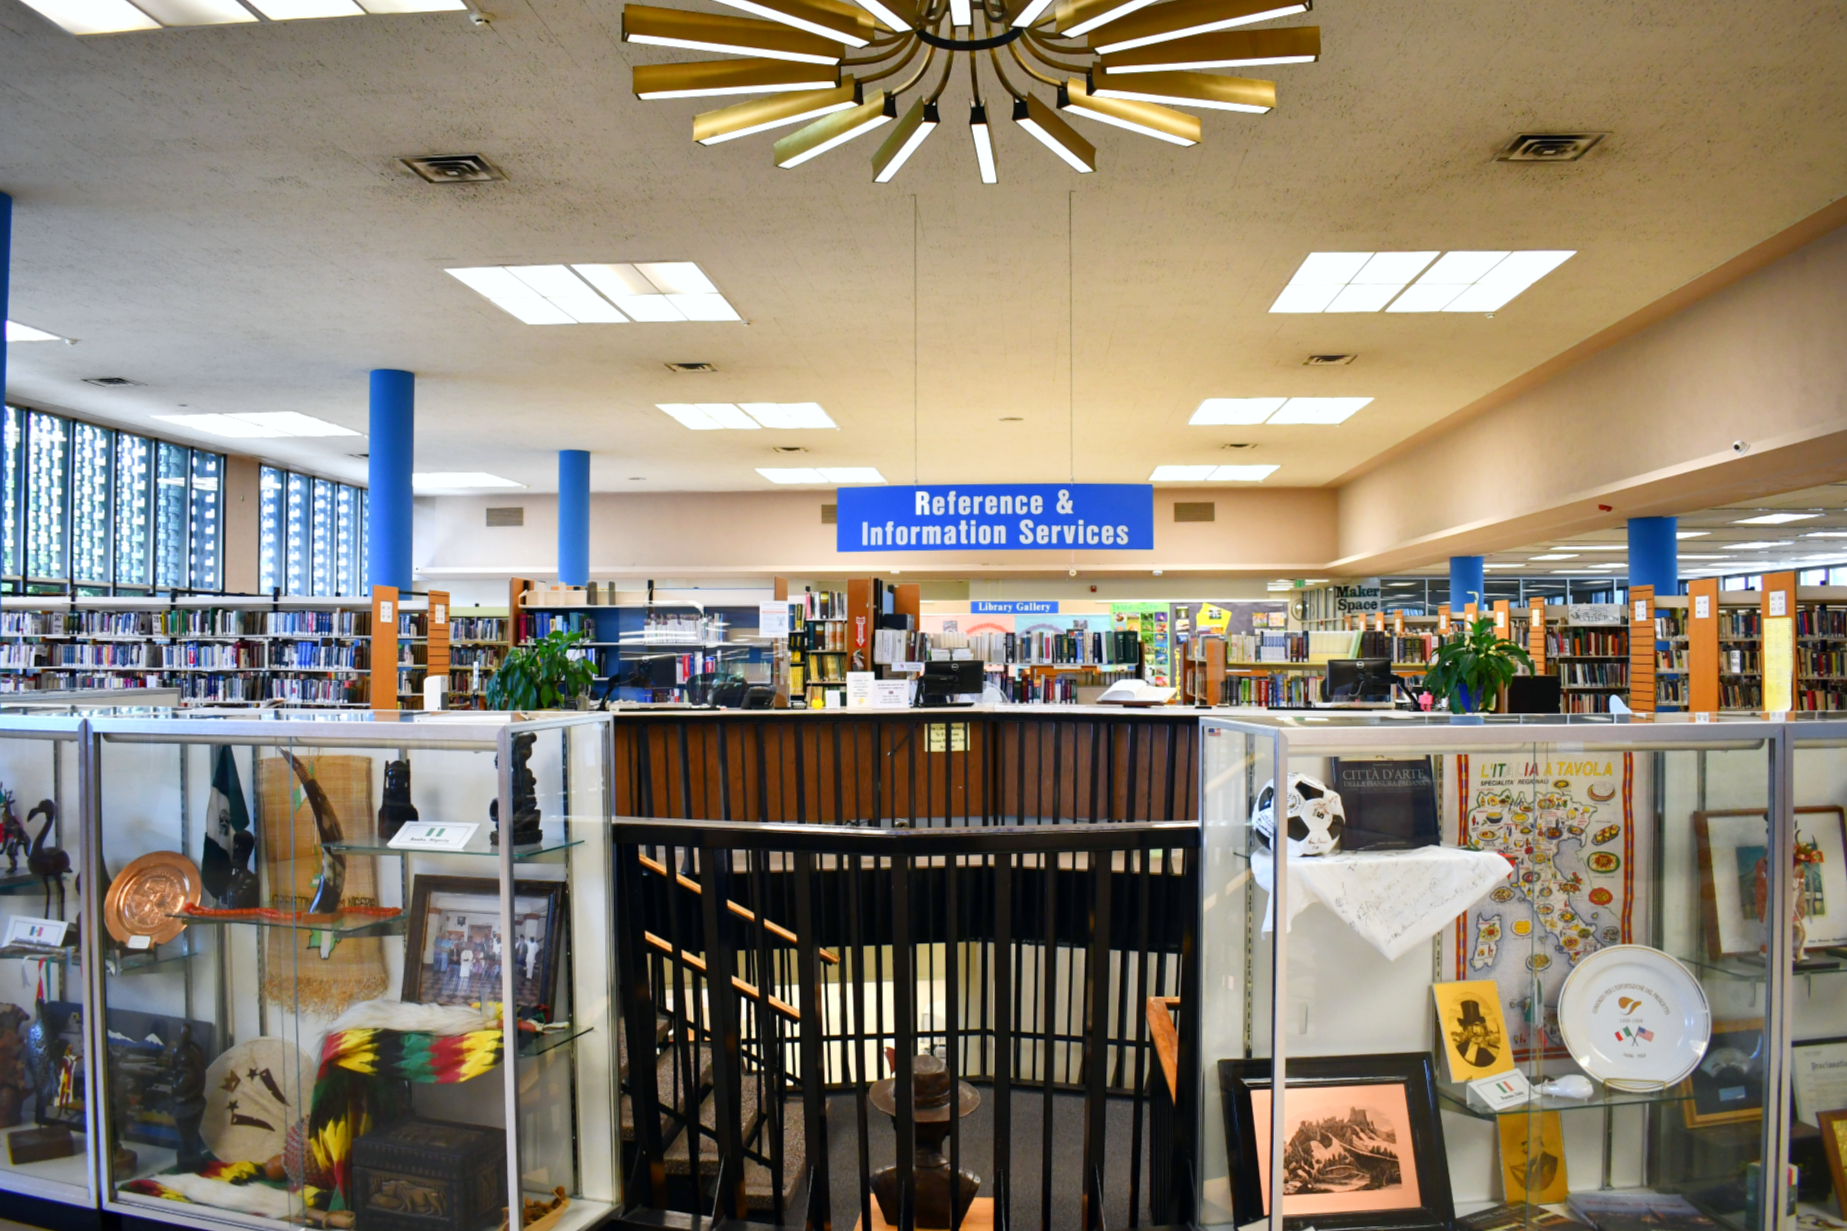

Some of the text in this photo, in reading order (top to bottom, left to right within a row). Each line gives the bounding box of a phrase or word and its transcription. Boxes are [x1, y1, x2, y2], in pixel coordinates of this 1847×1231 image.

[915, 489, 1074, 516] Reference &
[862, 519, 1130, 546] Information Services
[1335, 585, 1380, 598] Maker
[978, 602, 1051, 613] Library Gallery
[1337, 599, 1378, 614] Space
[1342, 768, 1425, 780] CITTÀ D'ARTE
[1480, 761, 1613, 778] L'ITALIA A TAVOLA
